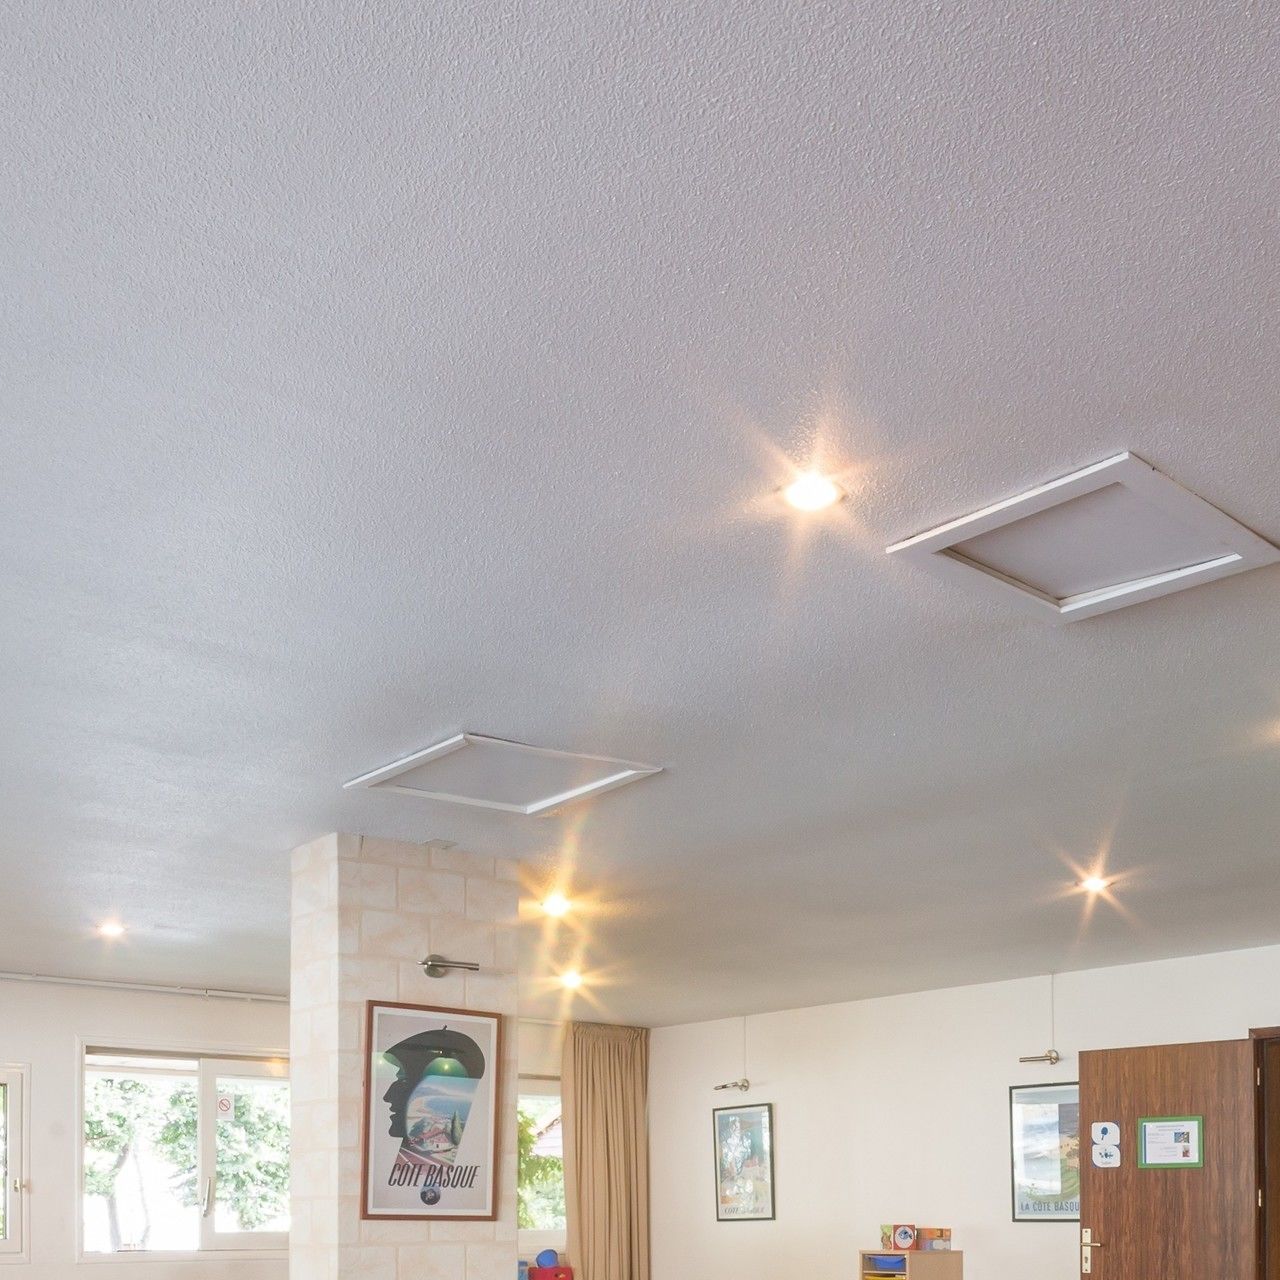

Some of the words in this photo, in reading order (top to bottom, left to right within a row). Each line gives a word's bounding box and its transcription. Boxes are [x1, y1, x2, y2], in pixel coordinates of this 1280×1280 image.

[423, 1163, 481, 1188] BASQUE
[1020, 1202, 1030, 1211] LA
[1054, 1201, 1080, 1212] BASQU
